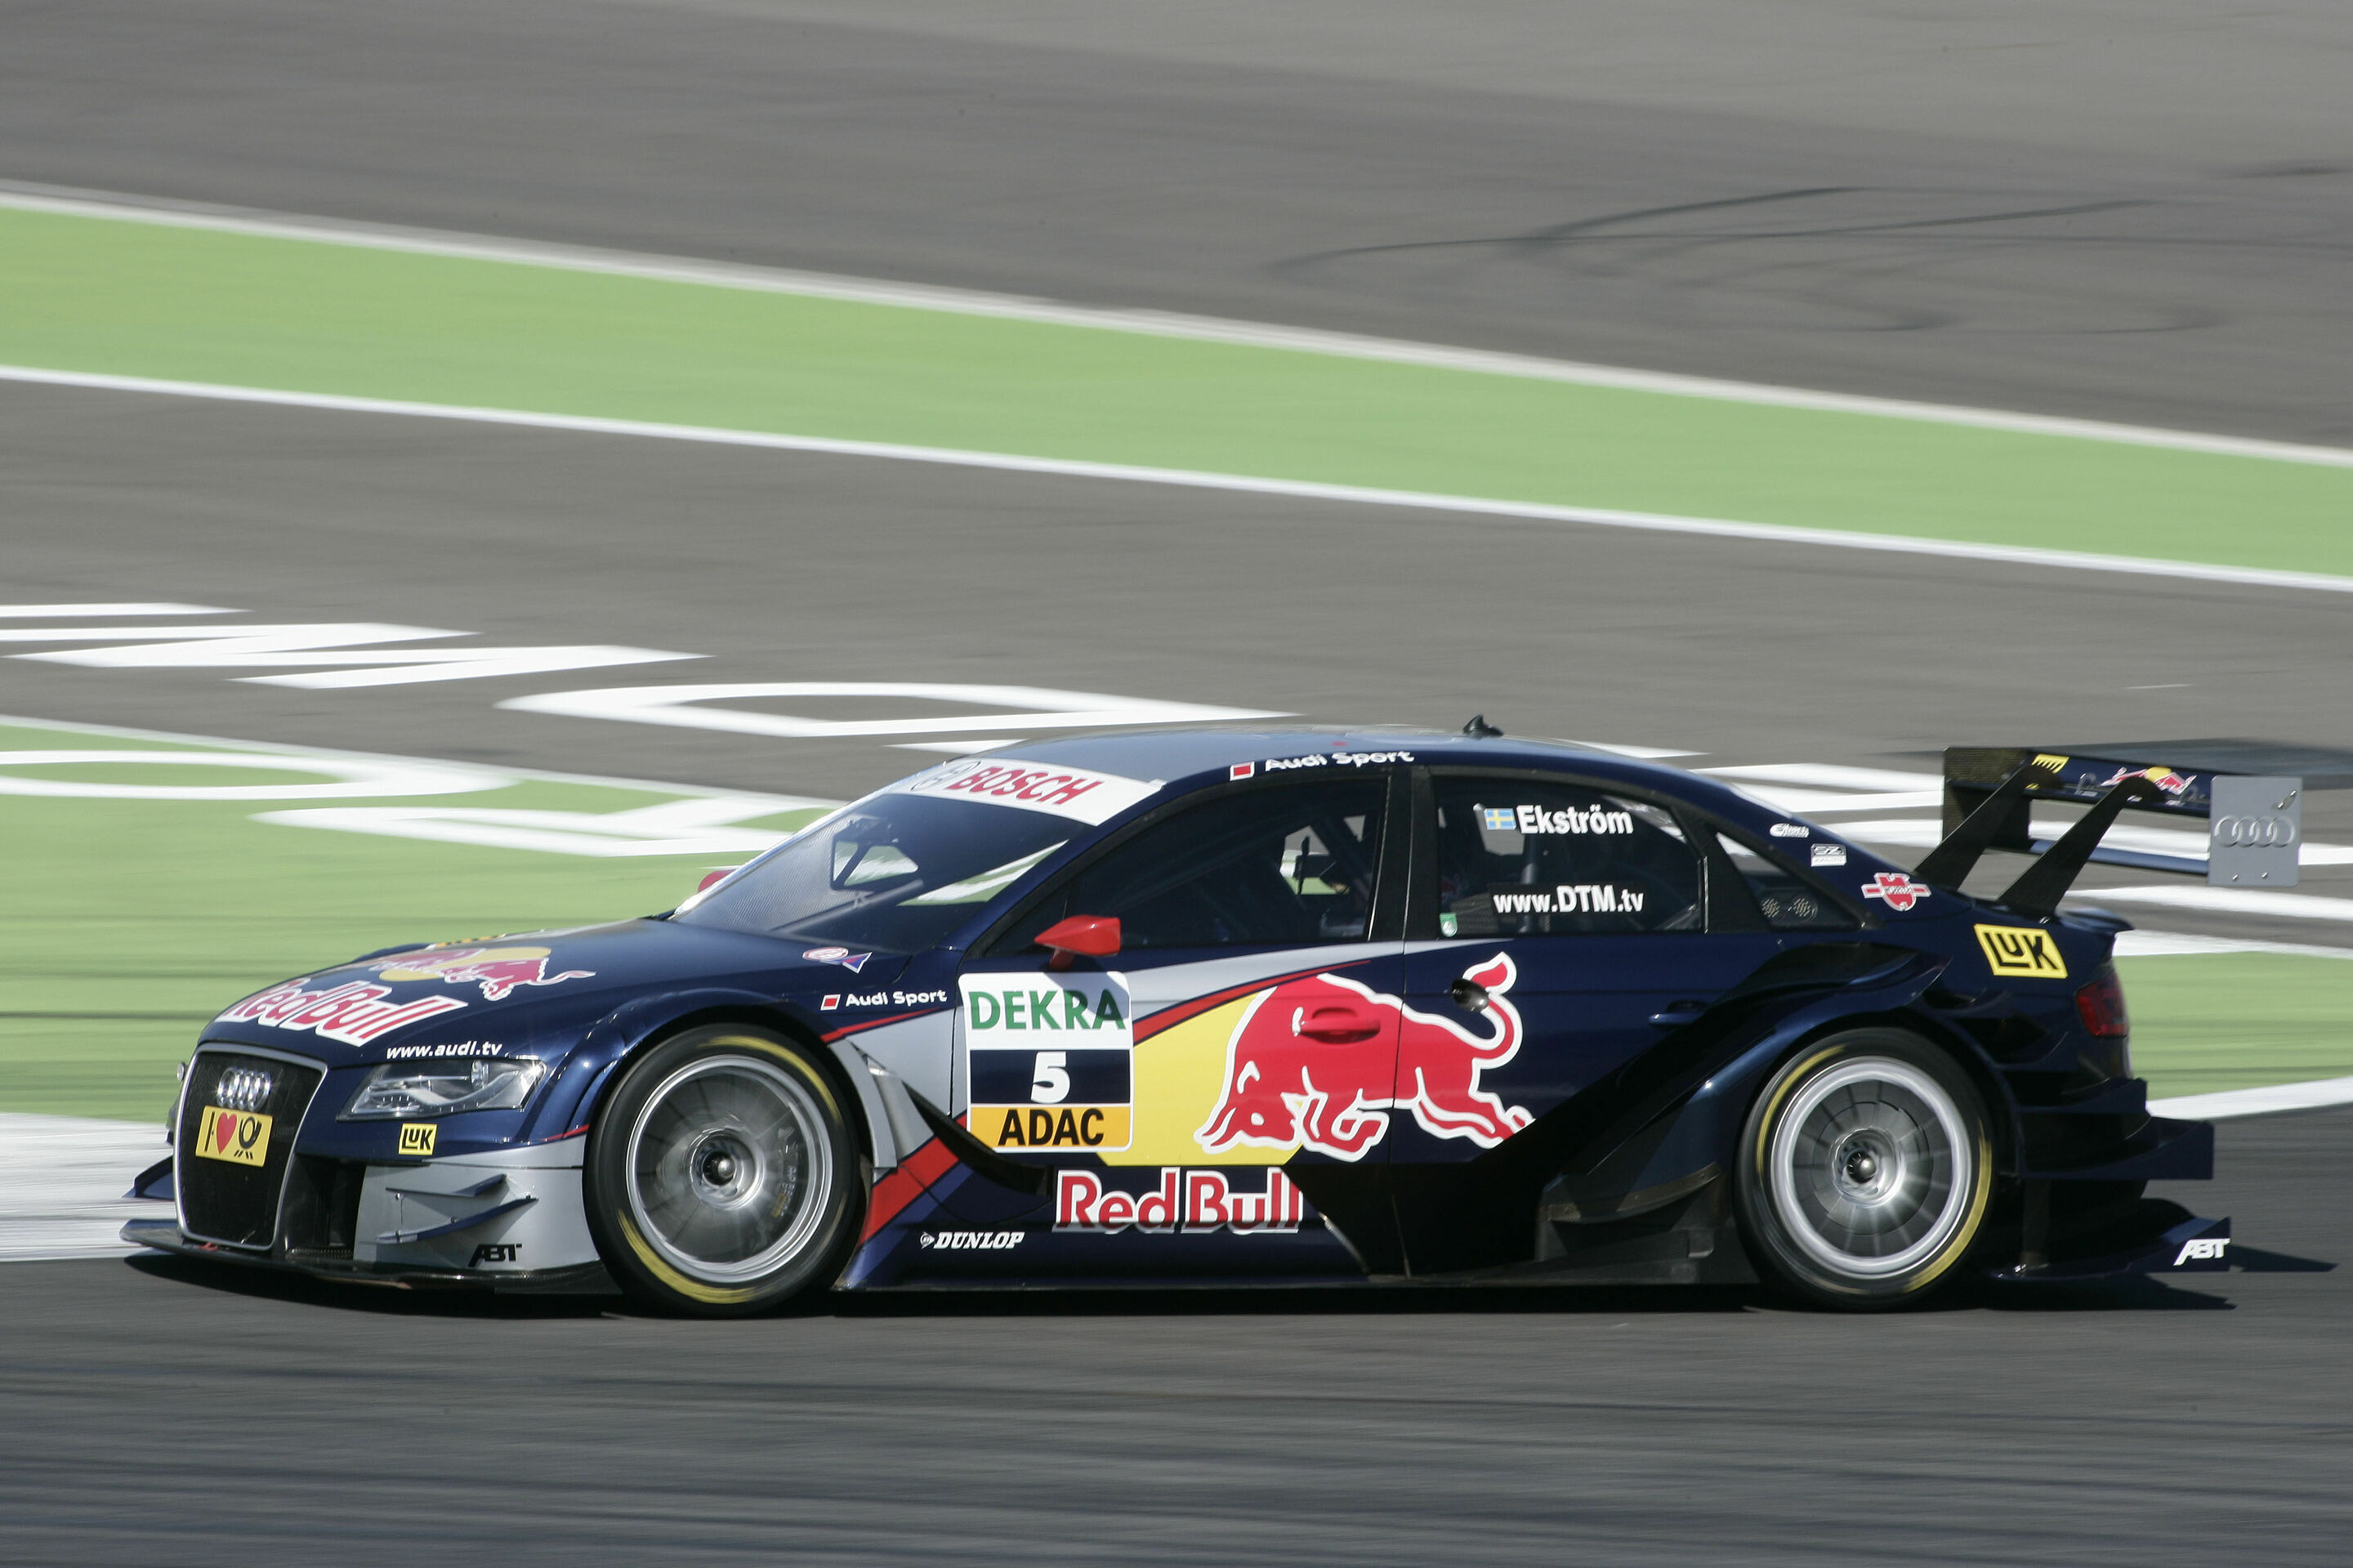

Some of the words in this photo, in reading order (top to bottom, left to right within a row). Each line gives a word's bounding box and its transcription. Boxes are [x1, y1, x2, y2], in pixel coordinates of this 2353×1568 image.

[1265, 753, 1328, 772] Audi
[1332, 750, 1415, 768] Sport
[945, 766, 1105, 805] BOSCH
[1516, 804, 1634, 834] Ekström
[1493, 884, 1644, 914] www.DTM.tv
[845, 991, 889, 1007] Audi
[893, 989, 948, 1007] Sport
[968, 989, 1127, 1030] DEKRA
[386, 1040, 503, 1060] www.audi.tv
[1030, 1051, 1071, 1104] 5
[998, 1108, 1105, 1146] ADAC
[933, 1231, 1025, 1249] DUNLOP
[2173, 1238, 2230, 1266] ABT
[468, 1244, 523, 1267] ABT
